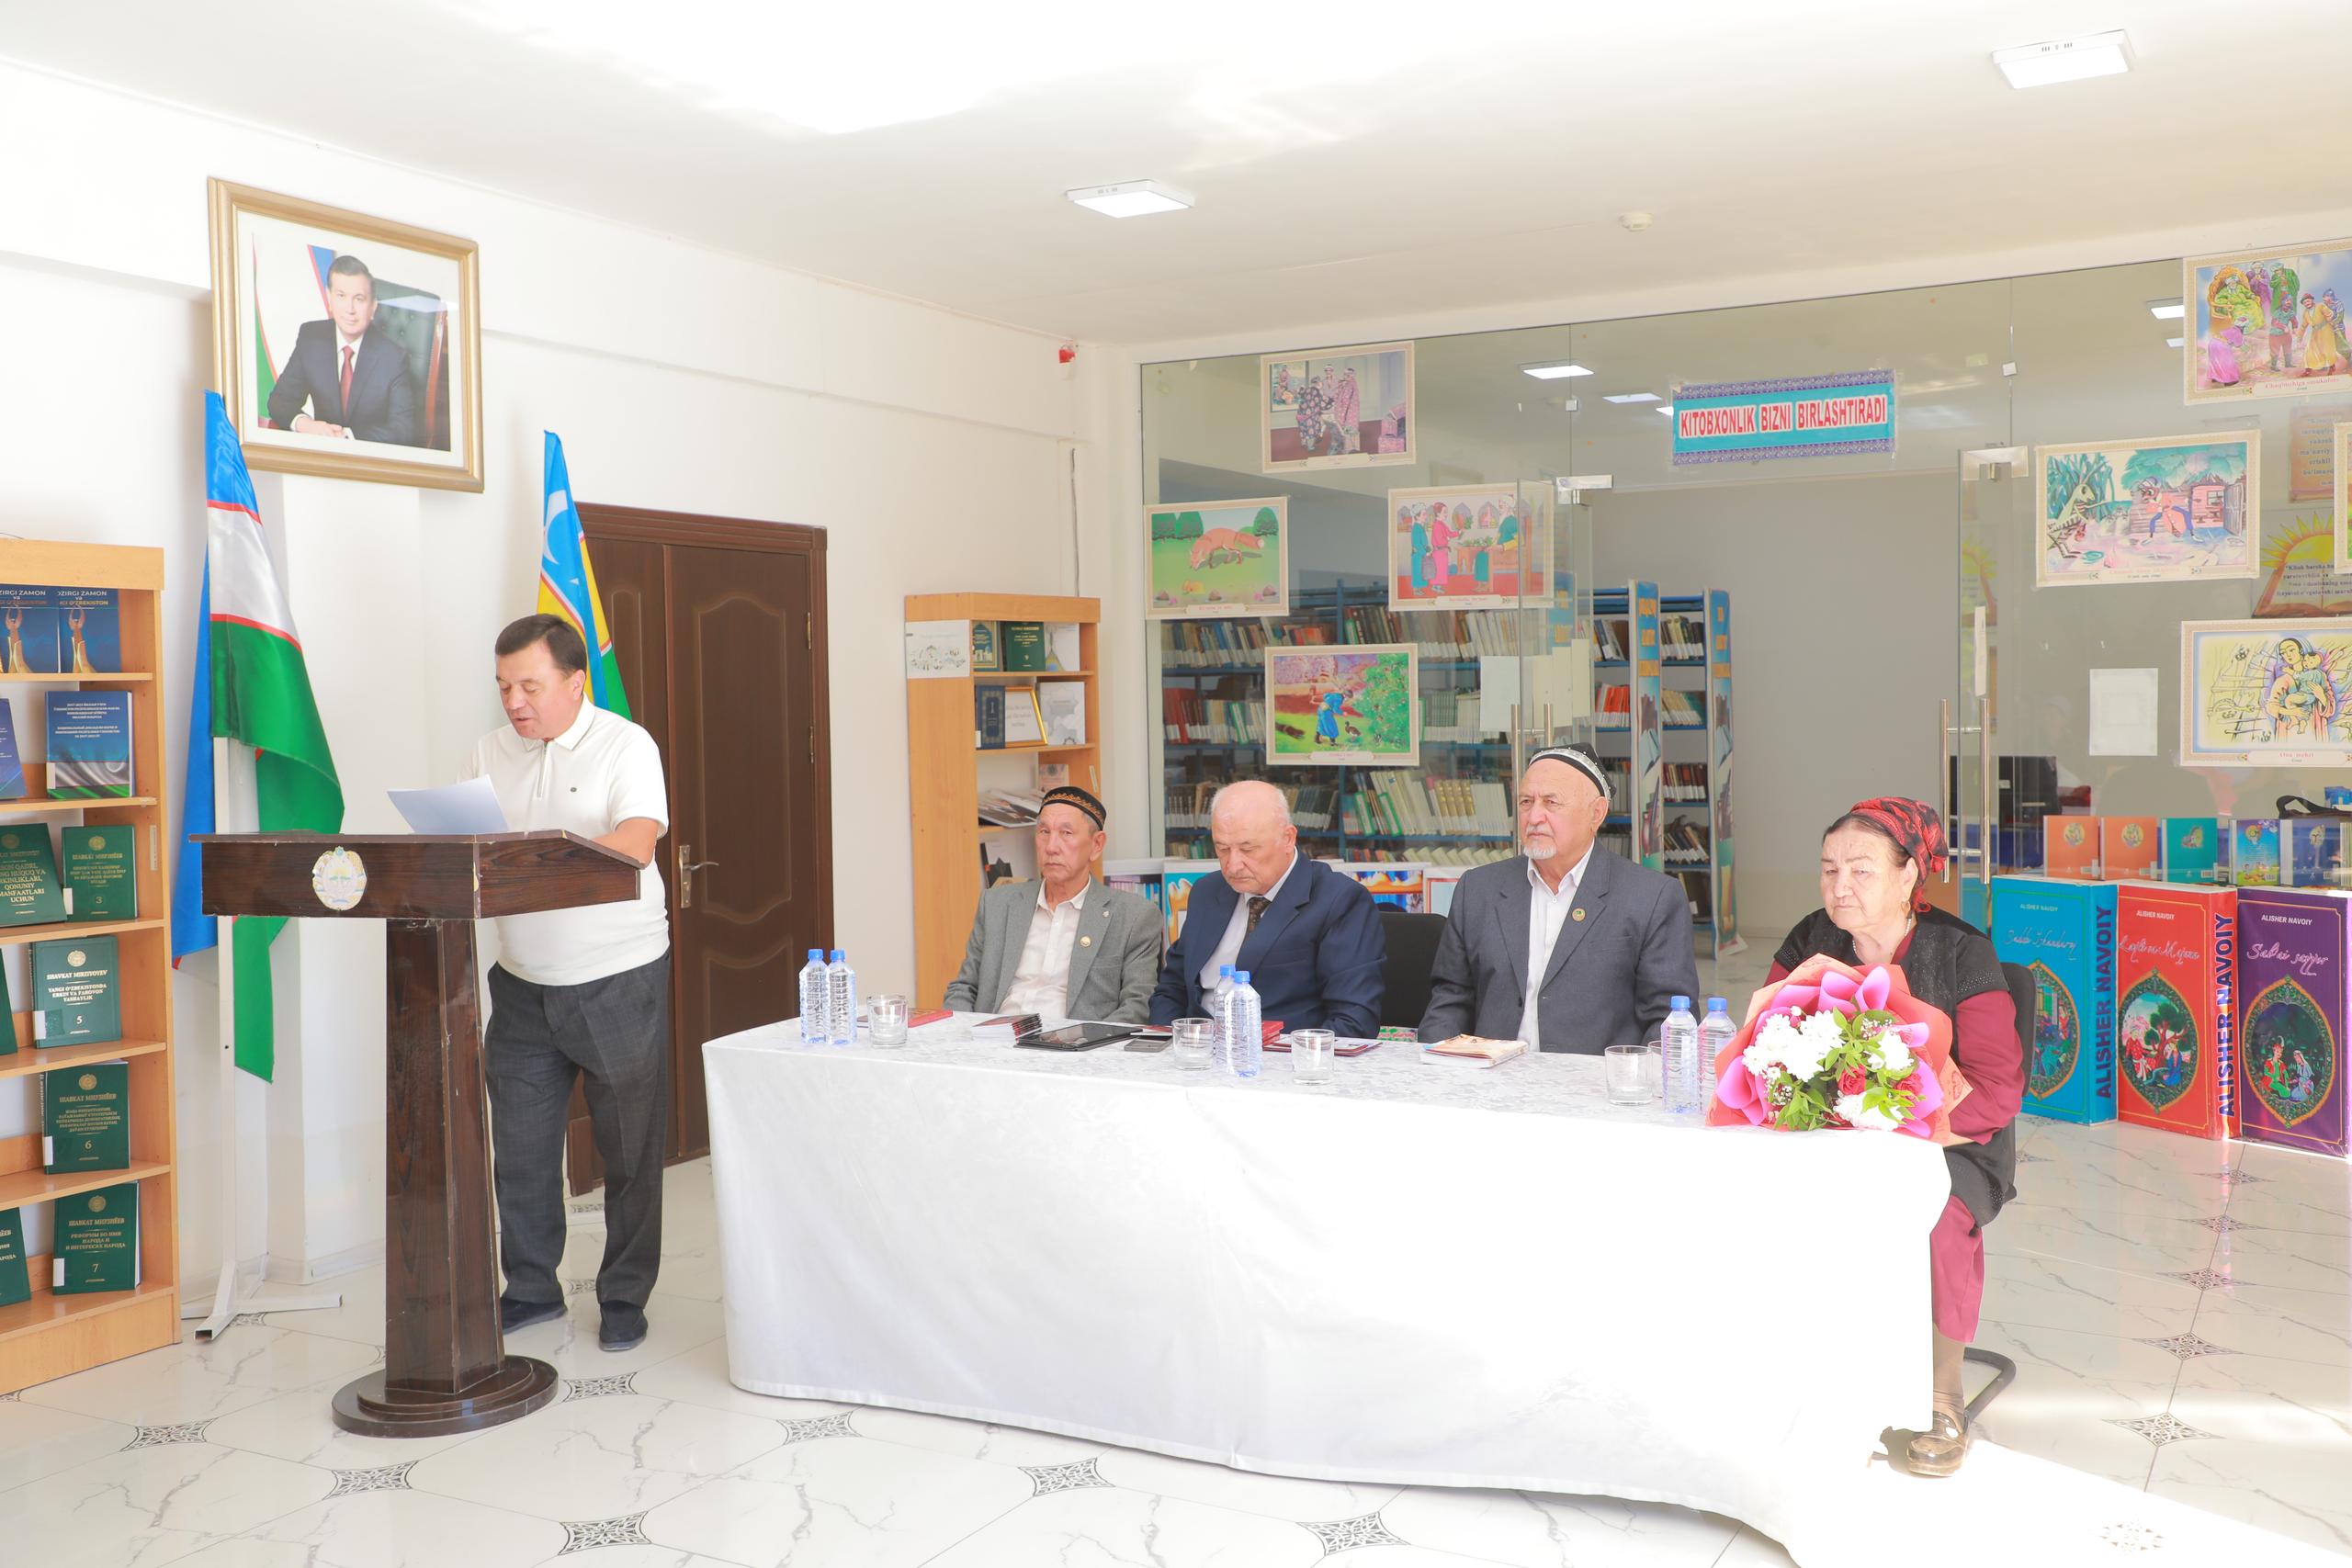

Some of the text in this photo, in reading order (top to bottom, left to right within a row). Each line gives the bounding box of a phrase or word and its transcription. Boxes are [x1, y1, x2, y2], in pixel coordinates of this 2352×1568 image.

[1680, 396, 1886, 437] KITOBXONLIK BIZNI BIRLASHTIRADI
[4, 883, 35, 891] QONUNIY
[2136, 910, 2156, 919] ALISHER
[2261, 914, 2312, 926] ALISHER NAVOIY
[2096, 906, 2112, 1100] ALISHER NAVOIY
[76, 1015, 83, 1024] 5
[2215, 912, 2235, 1118] ALISHER NAVOIY
[85, 1140, 92, 1149] 6
[92, 1263, 99, 1273] 7
